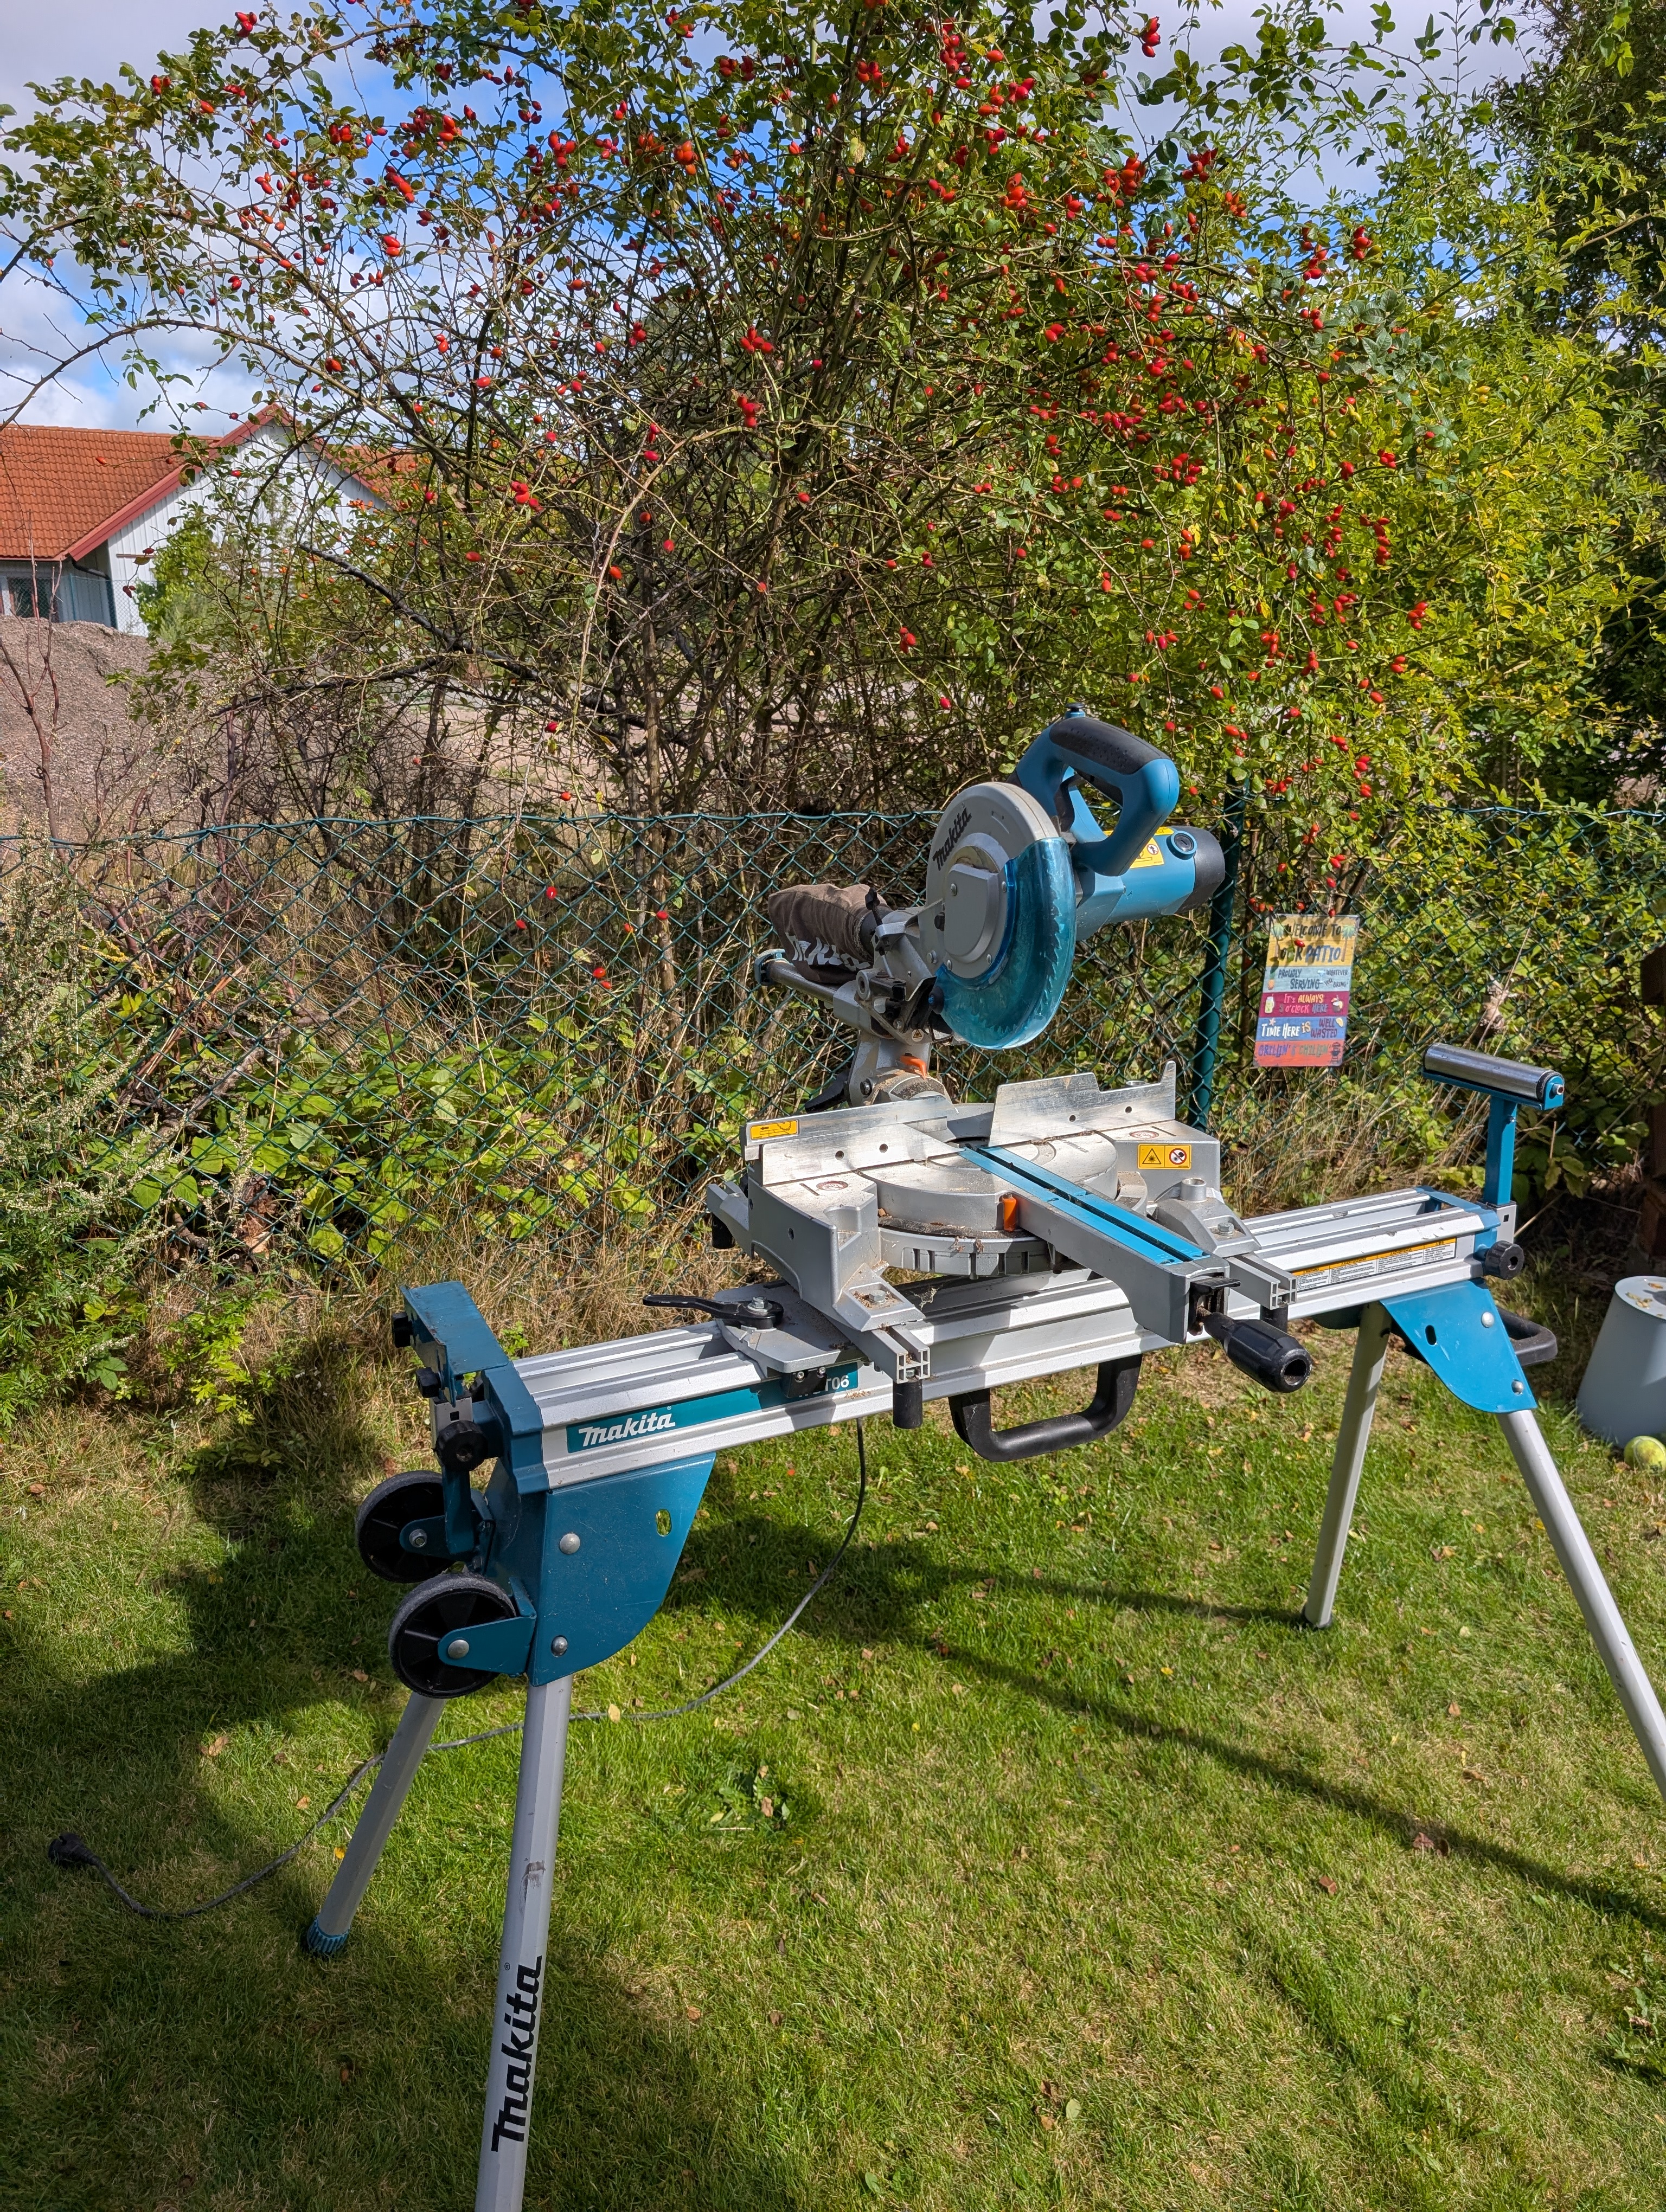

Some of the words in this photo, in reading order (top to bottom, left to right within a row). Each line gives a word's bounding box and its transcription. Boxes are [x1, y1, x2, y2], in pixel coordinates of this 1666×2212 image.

[932, 807, 972, 871] Makita
[1331, 924, 1341, 937] TO
[1280, 947, 1303, 962] OR
[1305, 945, 1341, 963] PATIO
[1278, 969, 1302, 978] PROUDLY
[1290, 978, 1323, 990] SERVING
[1324, 978, 1332, 986] YOU
[1298, 994, 1324, 1003] ALWAYS
[1312, 1004, 1328, 1013] HERE
[1319, 1018, 1335, 1027] WELL
[1261, 1023, 1281, 1037] TIME
[1282, 1023, 1300, 1039] HERE
[1310, 1028, 1337, 1038] WASTED
[579, 1412, 676, 1446] Makita
[491, 1955, 542, 2152] Makita
